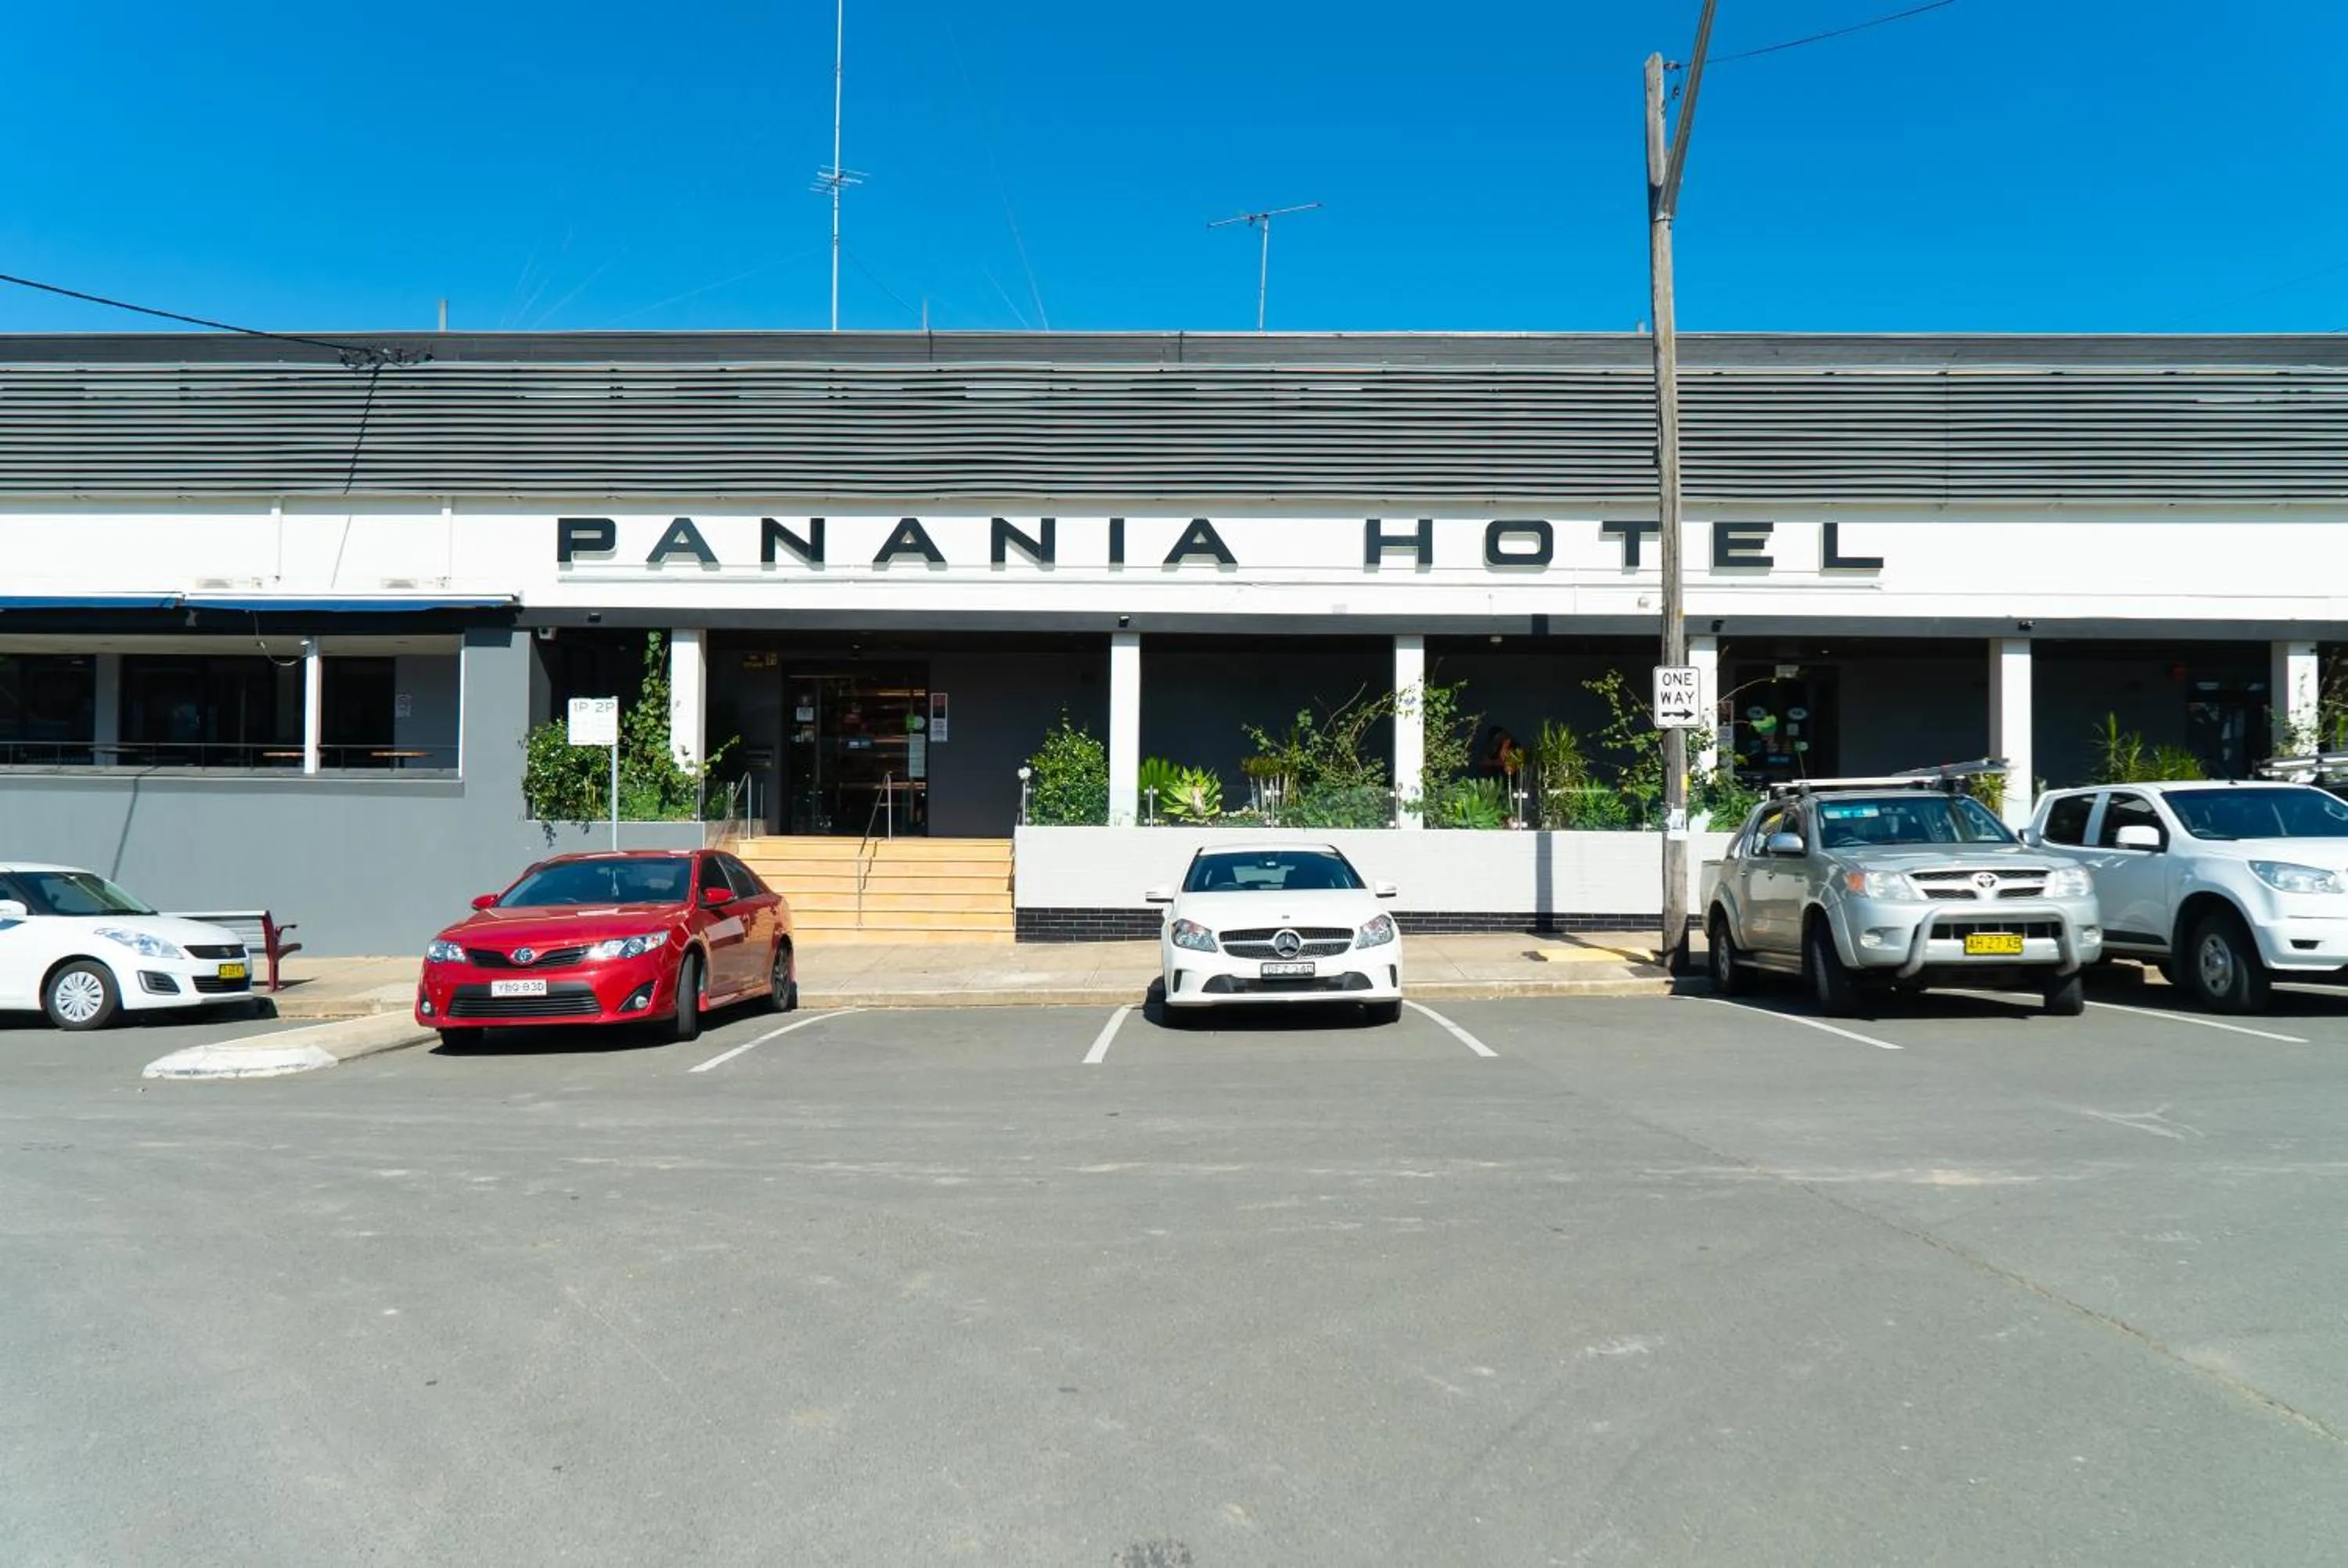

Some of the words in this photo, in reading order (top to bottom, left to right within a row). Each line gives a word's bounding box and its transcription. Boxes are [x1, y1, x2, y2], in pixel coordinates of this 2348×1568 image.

[557, 517, 1238, 564] PANANIA
[1365, 519, 1884, 568] HOTEL
[1662, 672, 1694, 686] ONE
[1660, 691, 1694, 705] WAY
[574, 701, 589, 712] 1P
[595, 701, 615, 713] 2P
